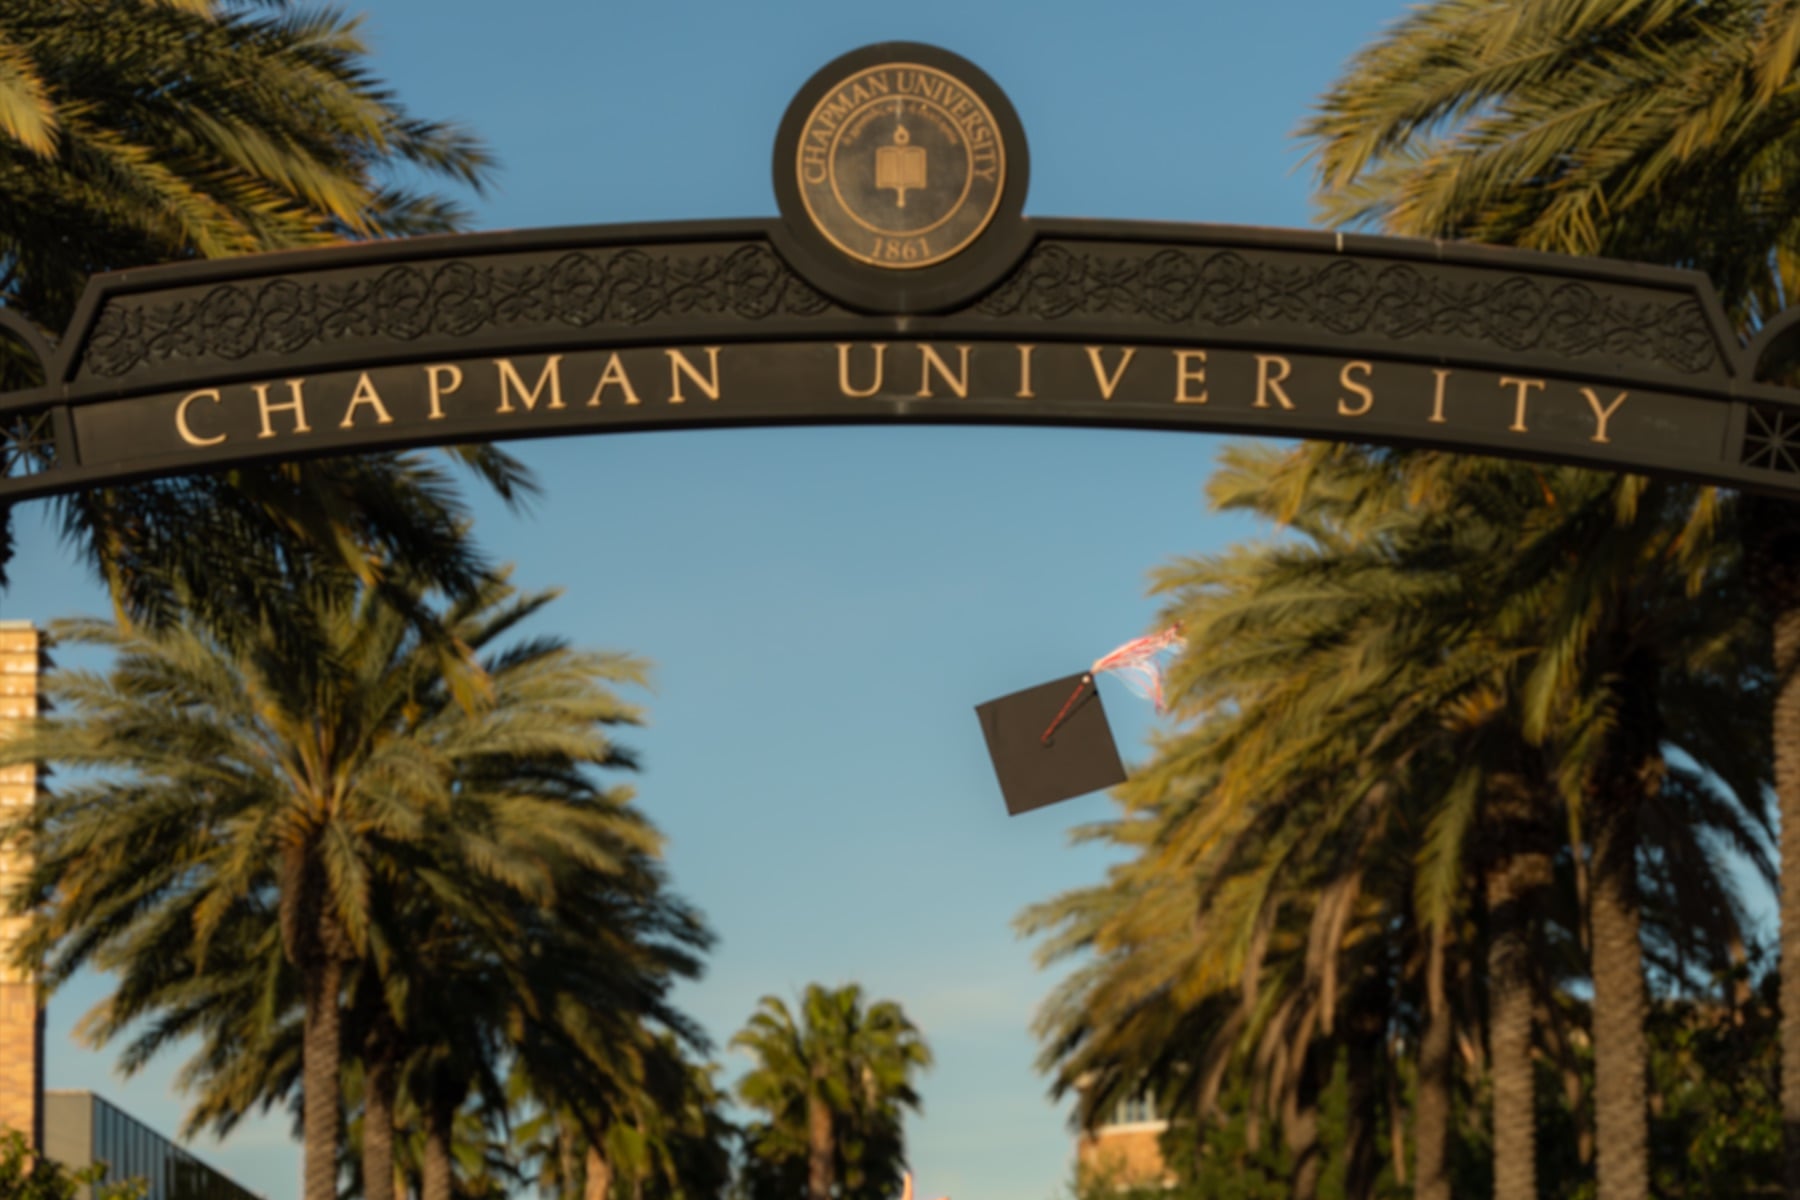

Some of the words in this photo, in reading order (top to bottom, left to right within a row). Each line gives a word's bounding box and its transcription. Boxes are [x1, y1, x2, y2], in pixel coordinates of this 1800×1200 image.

[804, 72, 889, 185] CHAPMAN
[896, 71, 997, 182] UNIVERSITY
[871, 236, 931, 260] 1861
[174, 346, 722, 448] CHAPMAN
[835, 343, 1628, 444] UNIVERSITY
